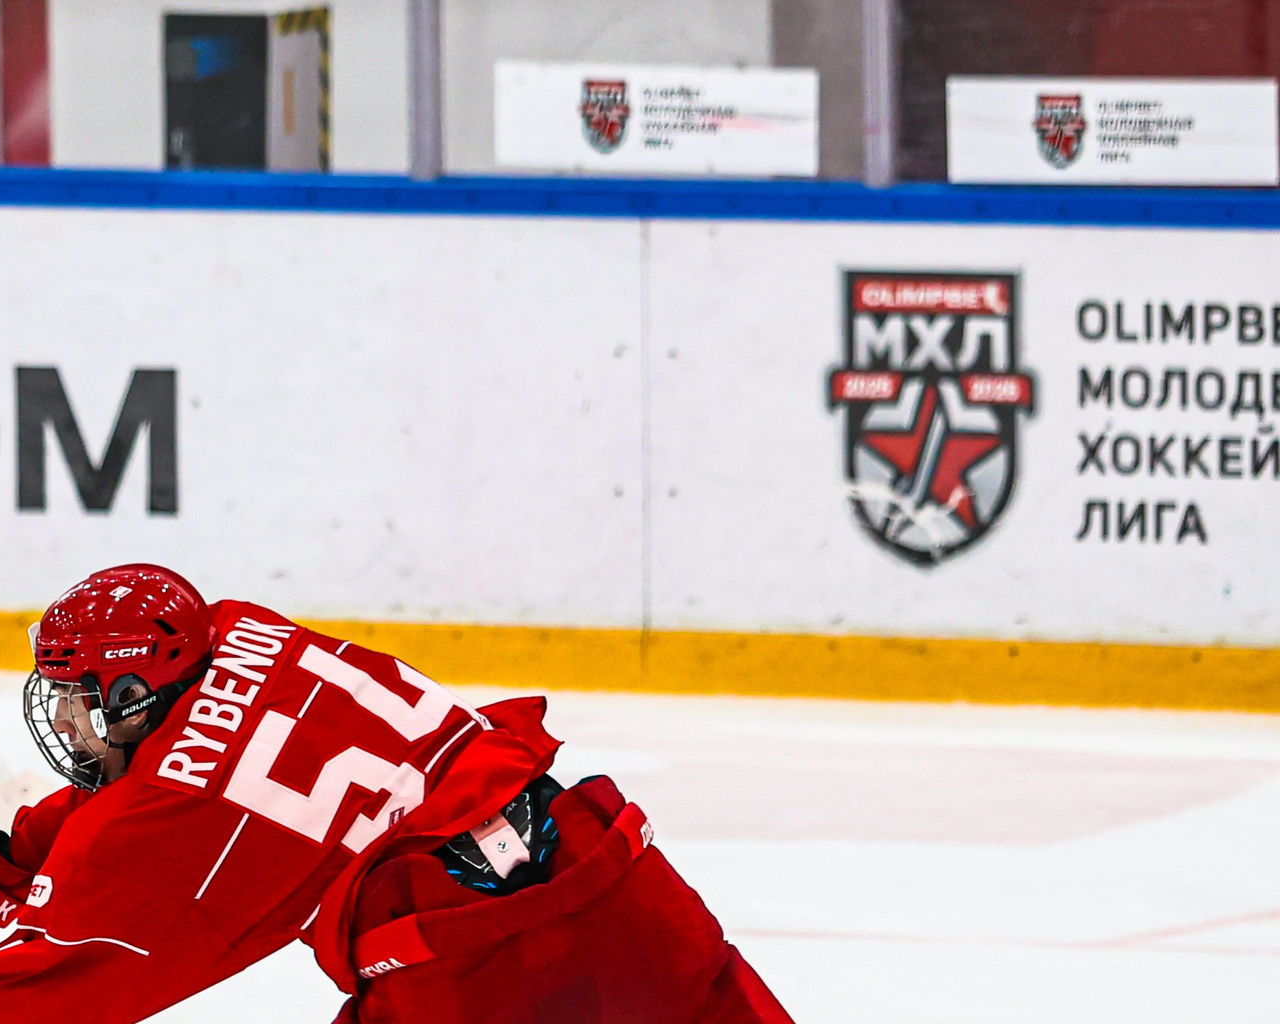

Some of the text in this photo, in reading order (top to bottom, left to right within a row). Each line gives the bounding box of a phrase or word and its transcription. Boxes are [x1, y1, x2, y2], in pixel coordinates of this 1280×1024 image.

[851, 314, 1008, 370] МХЛ
[1075, 501, 1209, 545] ЛИГА
[104, 646, 149, 660] CCM
[121, 695, 157, 717] BAUER
[156, 616, 297, 789] RYBENOK
[222, 643, 494, 855] 54
